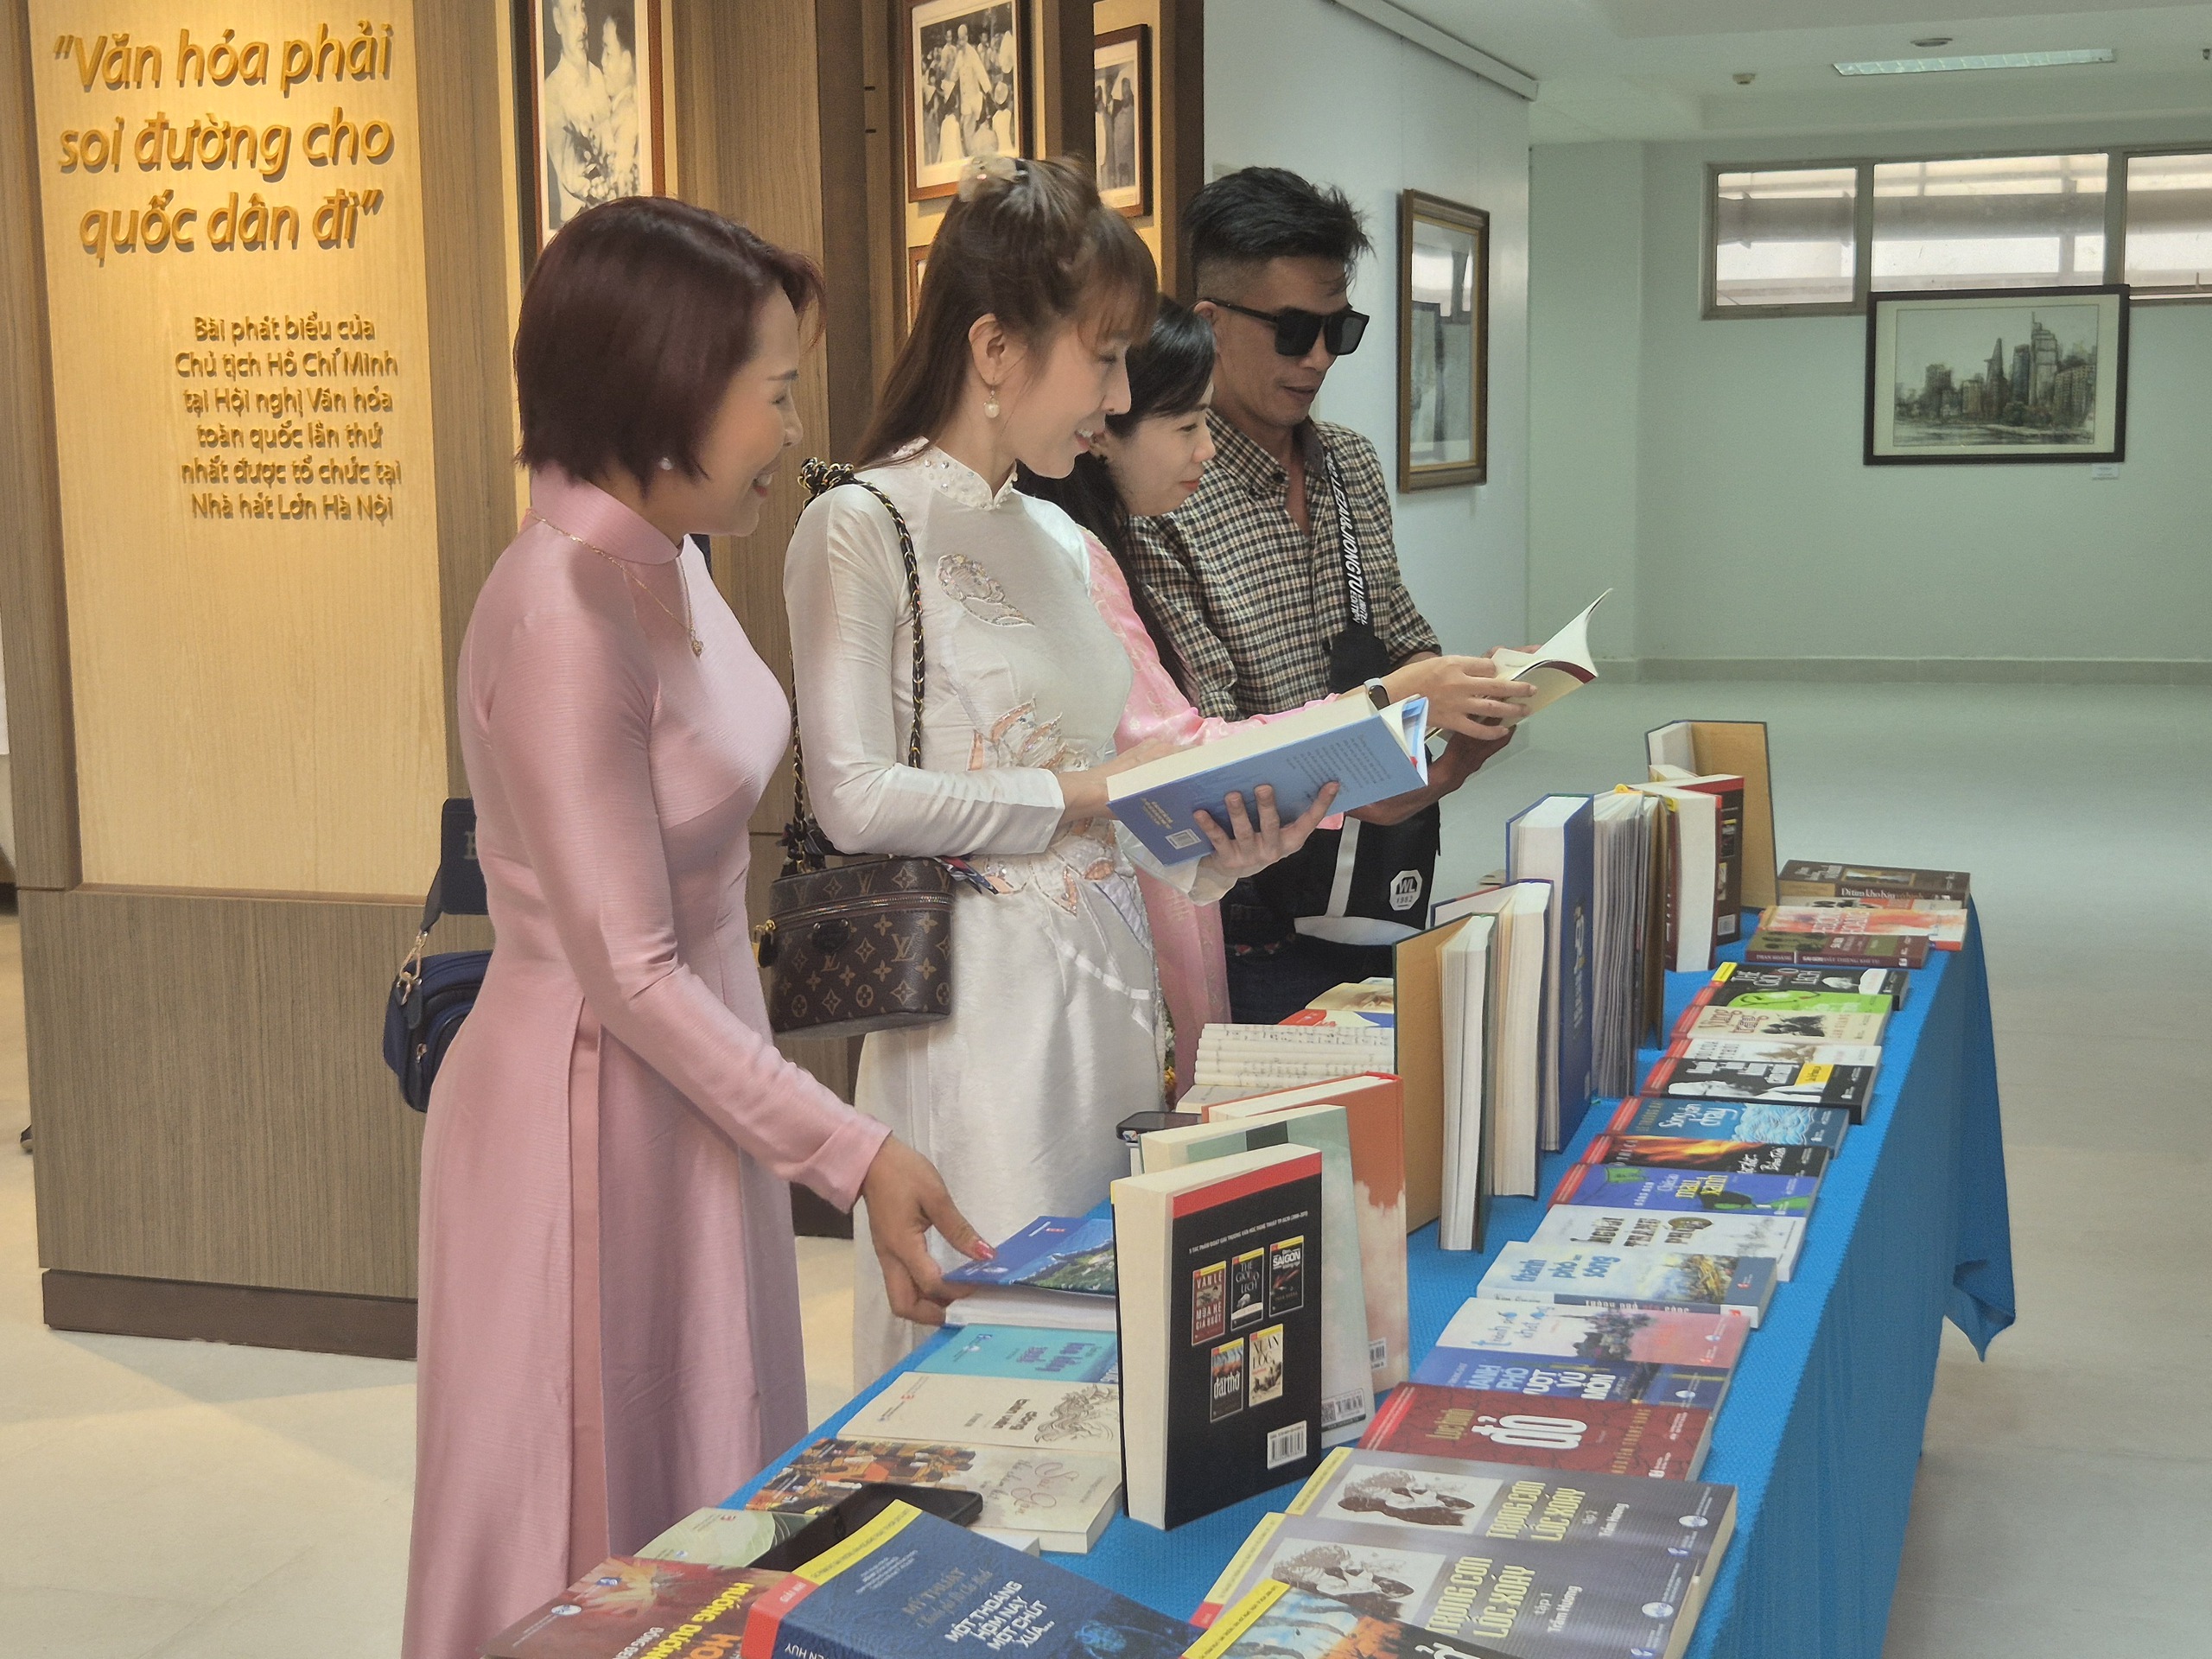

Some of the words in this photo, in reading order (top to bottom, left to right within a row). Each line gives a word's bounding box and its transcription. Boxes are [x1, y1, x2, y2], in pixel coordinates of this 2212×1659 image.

[176, 29, 269, 87] hóa
[281, 21, 393, 98] phải
[59, 117, 124, 172] soi
[135, 111, 291, 182] đường
[303, 106, 394, 165] cho
[80, 189, 197, 267] quốc
[207, 191, 299, 252] dân
[194, 316, 225, 341] Bài
[232, 315, 281, 346] phát
[285, 311, 332, 340] biểu
[338, 314, 376, 340] của
[175, 350, 217, 378] Chủ
[223, 352, 261, 381] tịch
[268, 347, 297, 377] Hồ
[302, 346, 341, 377] Chí
[343, 350, 398, 377] Minh
[183, 389, 209, 418] tại
[215, 388, 250, 417] Hội
[256, 387, 304, 419] nghị
[307, 387, 346, 412] Văn
[353, 385, 393, 412] hóa
[196, 423, 245, 448] toàn
[250, 420, 302, 454] quốc
[308, 420, 340, 448] lần
[346, 421, 384, 448] thứ
[181, 454, 229, 484] nhất
[233, 457, 286, 488] được
[291, 454, 314, 484] tổ
[318, 455, 370, 484] chức
[374, 460, 402, 489] tại
[192, 493, 233, 518] Nhà
[239, 492, 273, 518] hát
[278, 492, 316, 519] Lớn
[323, 493, 351, 519] Hà
[357, 493, 393, 526] Nội
[691, 1582, 755, 1623] HƯỚNG
[969, 1580, 1023, 1621] THOÁNG
[1000, 1595, 1030, 1624] NAY
[1011, 1599, 1047, 1630] CHÚT
[640, 1624, 703, 1659] DƯƠN
[683, 1633, 742, 1659] HO
[784, 1643, 808, 1658] HUY
